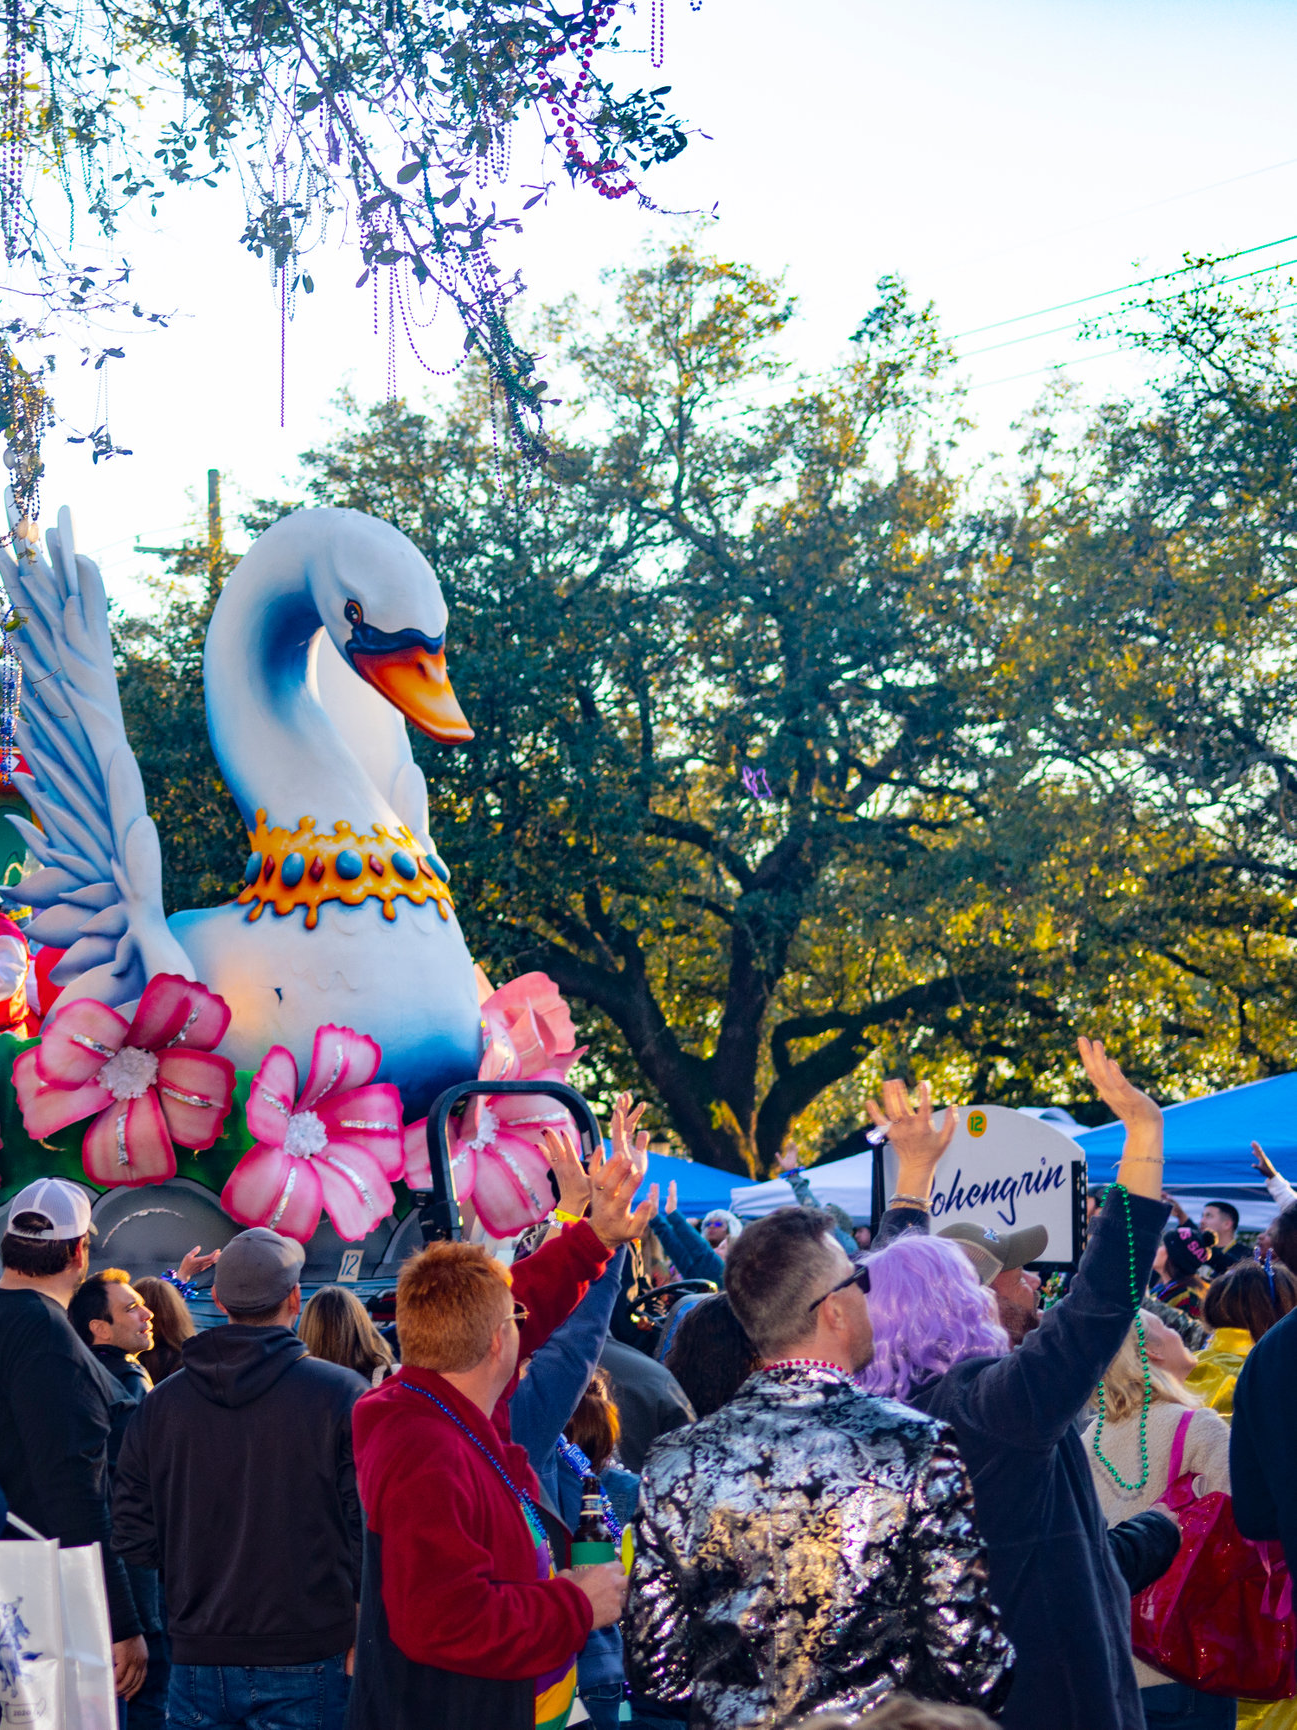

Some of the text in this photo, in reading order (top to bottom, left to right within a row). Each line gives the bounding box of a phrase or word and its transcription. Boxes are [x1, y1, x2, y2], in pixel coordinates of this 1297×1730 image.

[970, 1116, 984, 1132] 12
[930, 1157, 1066, 1226] ohengrin
[341, 1254, 359, 1276] 12
